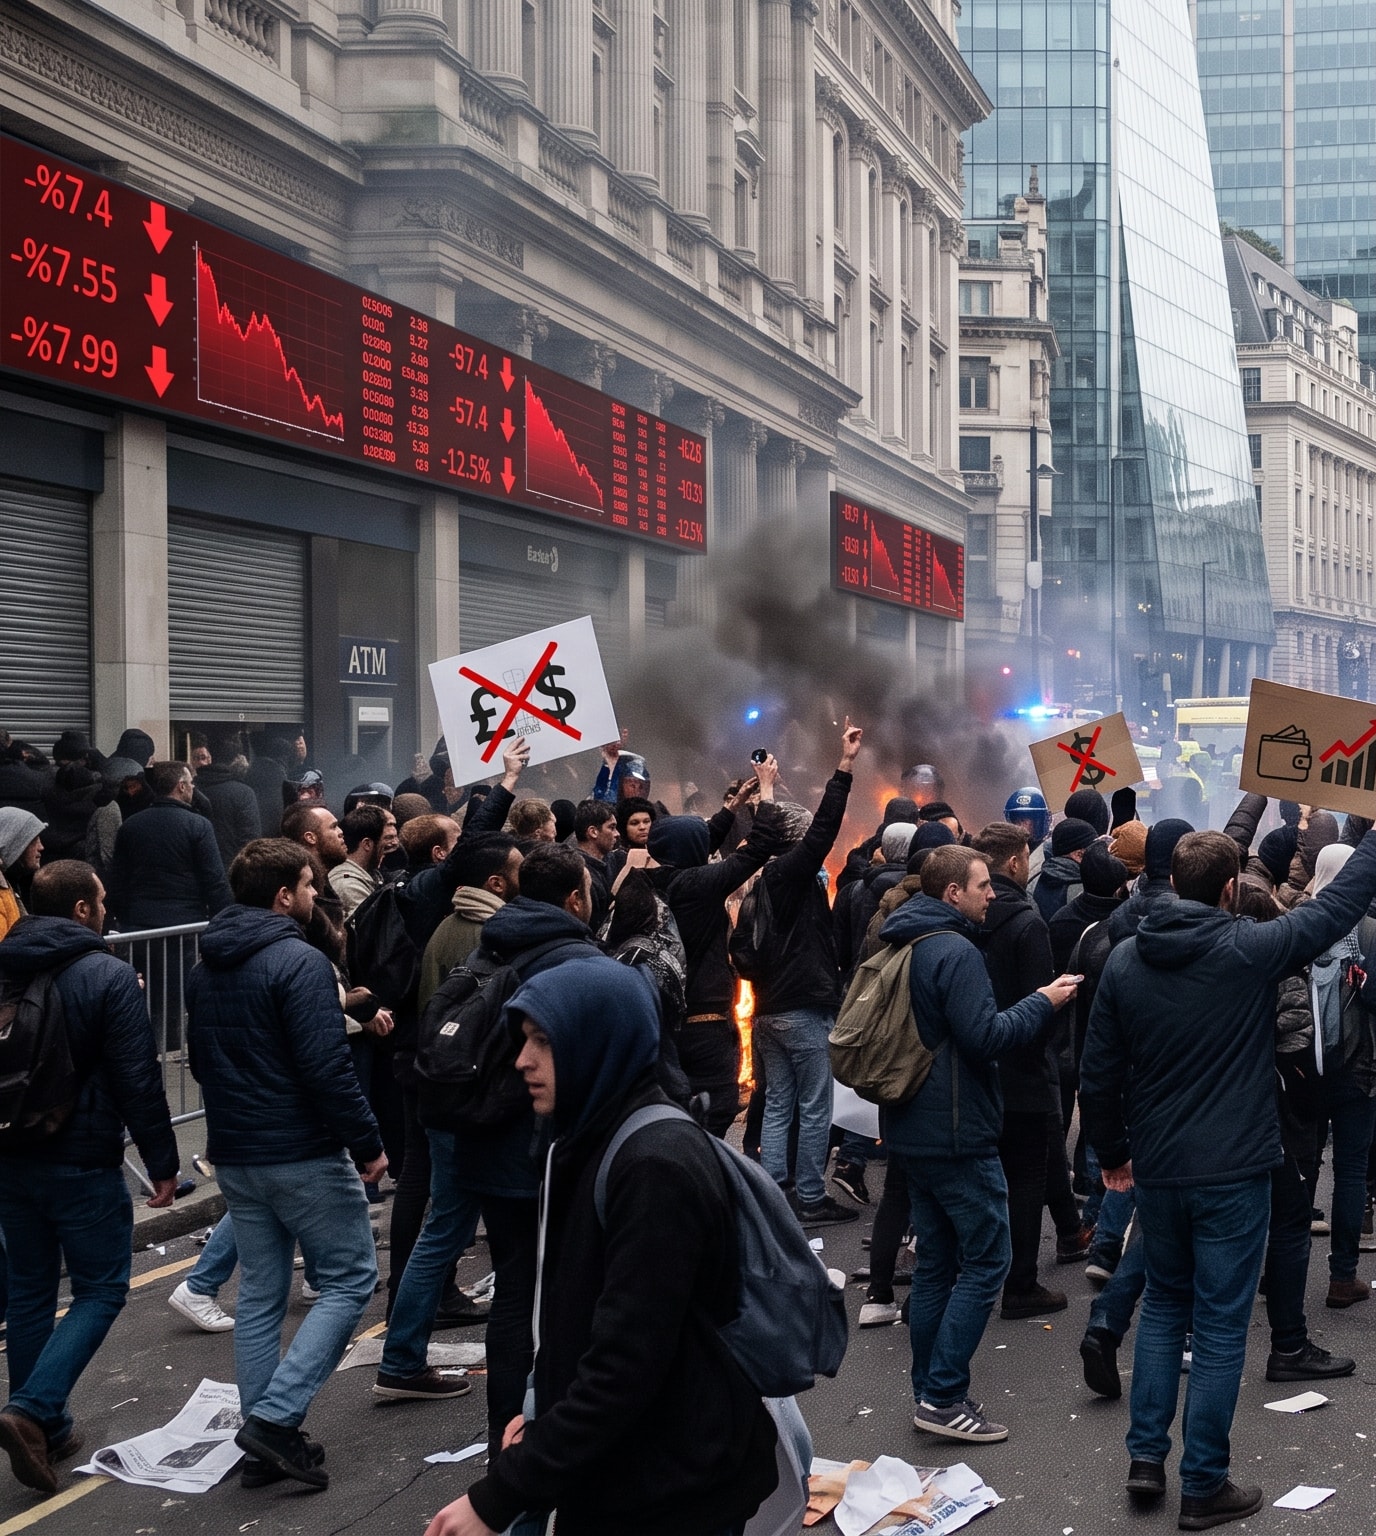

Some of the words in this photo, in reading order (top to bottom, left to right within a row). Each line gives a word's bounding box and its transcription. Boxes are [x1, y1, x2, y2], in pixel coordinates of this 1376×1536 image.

[23, 163, 114, 229] -%7.4
[10, 237, 119, 304] -%7.55
[10, 315, 120, 379] -%7.99
[448, 395, 489, 432] -57.4
[440, 447, 492, 485] -12.5%
[348, 645, 387, 676] ATM
[469, 686, 516, 746] £
[534, 661, 577, 727] $
[1069, 732, 1106, 790] $
